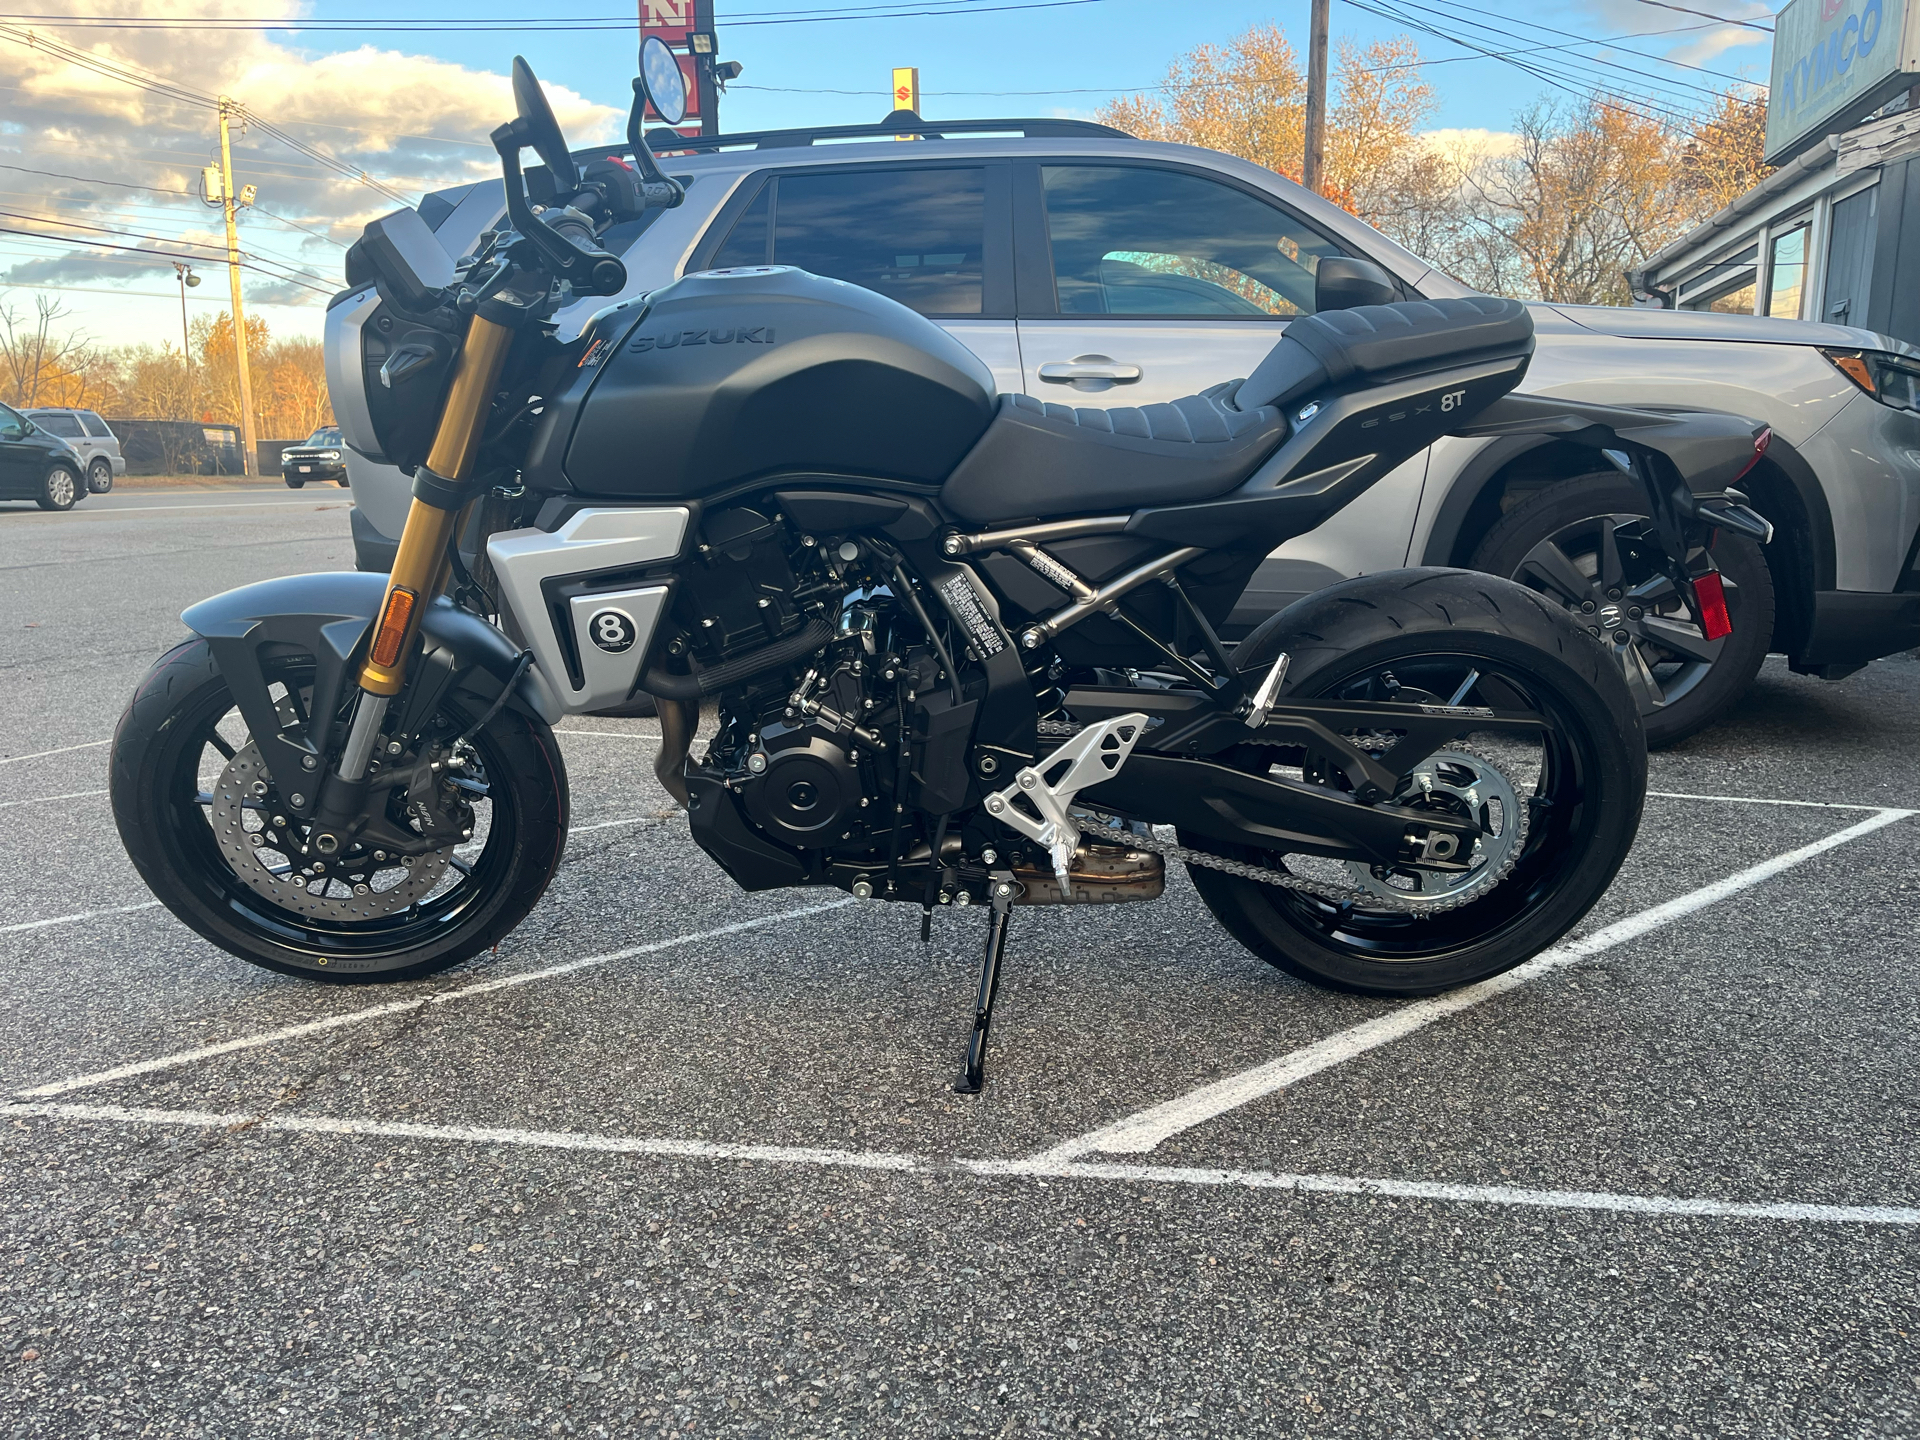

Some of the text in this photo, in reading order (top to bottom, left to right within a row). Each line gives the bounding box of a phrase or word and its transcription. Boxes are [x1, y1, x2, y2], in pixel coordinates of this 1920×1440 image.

[1780, 0, 1883, 120] KYMCO
[628, 326, 776, 354] SUZUKI
[1440, 389, 1466, 412] 8T
[598, 614, 625, 643] 8
